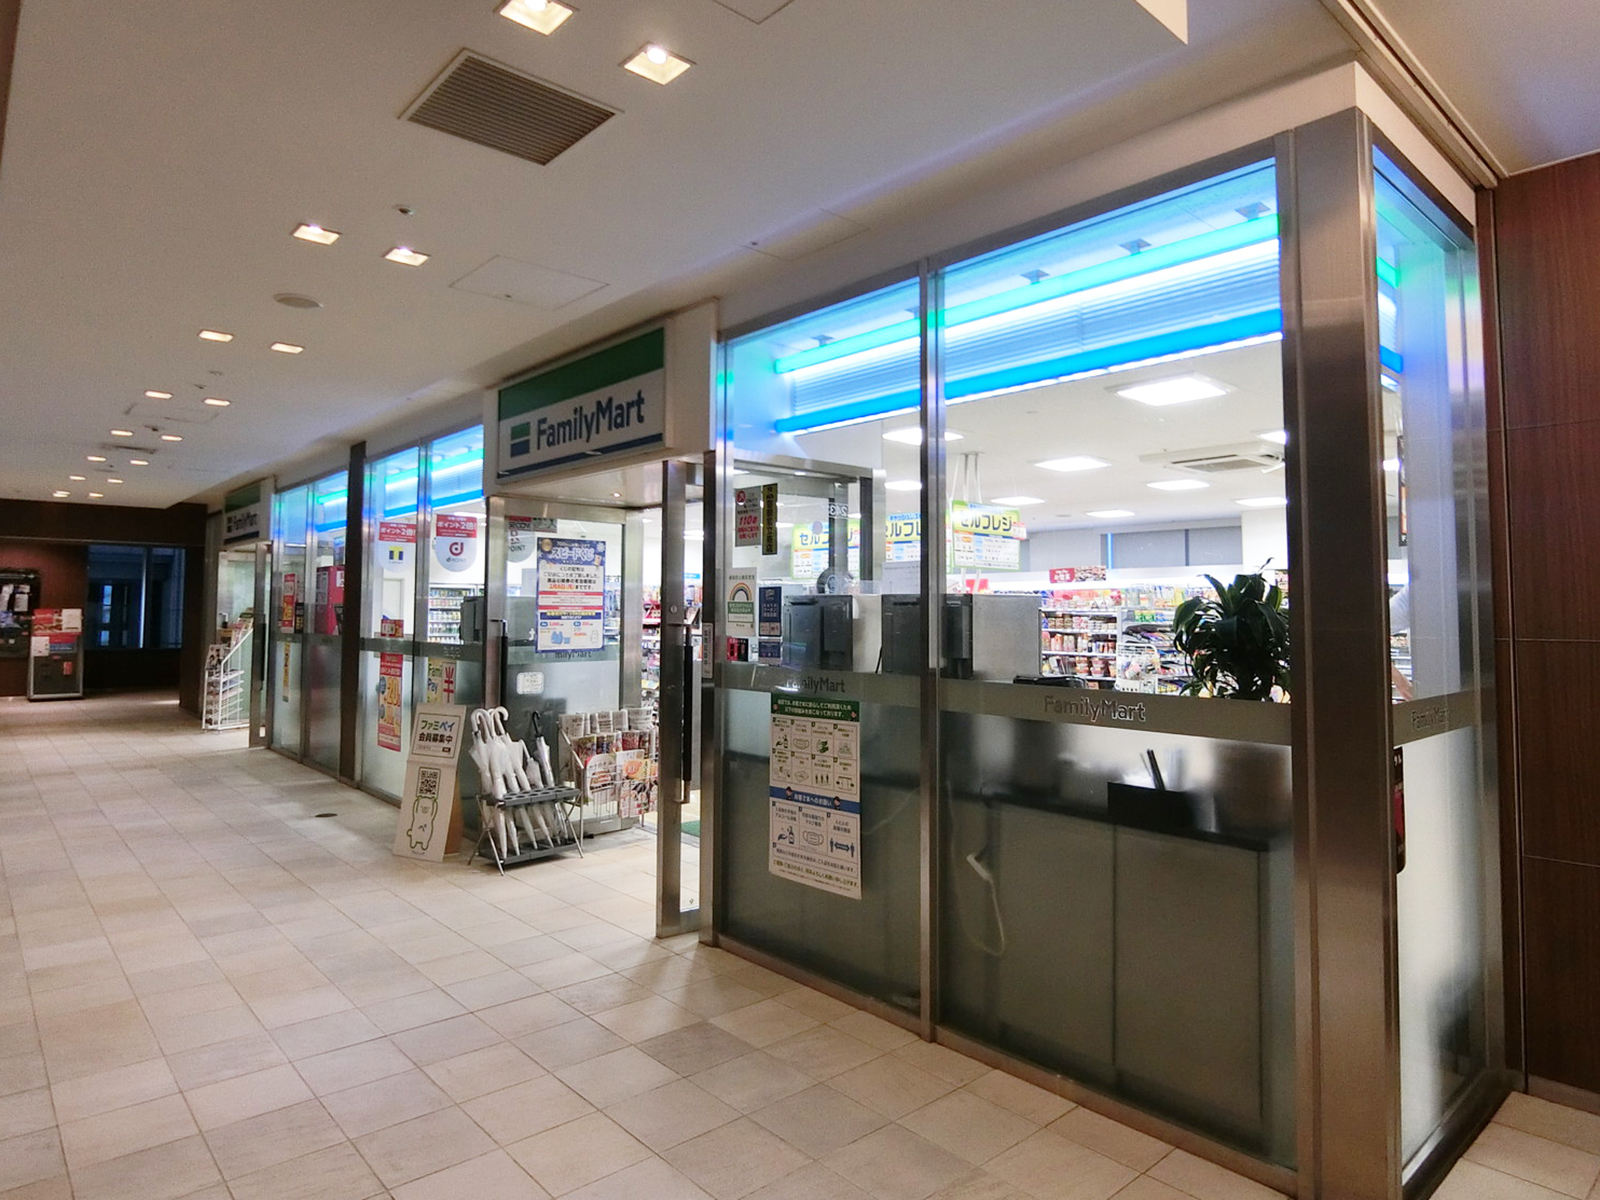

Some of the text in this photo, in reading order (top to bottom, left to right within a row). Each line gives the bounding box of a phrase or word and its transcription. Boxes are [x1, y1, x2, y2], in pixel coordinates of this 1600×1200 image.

[537, 389, 645, 450] FamilyMart
[551, 547, 595, 561] スピードくじ
[1043, 696, 1146, 722] FamilyMart
[421, 720, 455, 732] ファミペイ
[418, 732, 453, 744] 会員募集中
